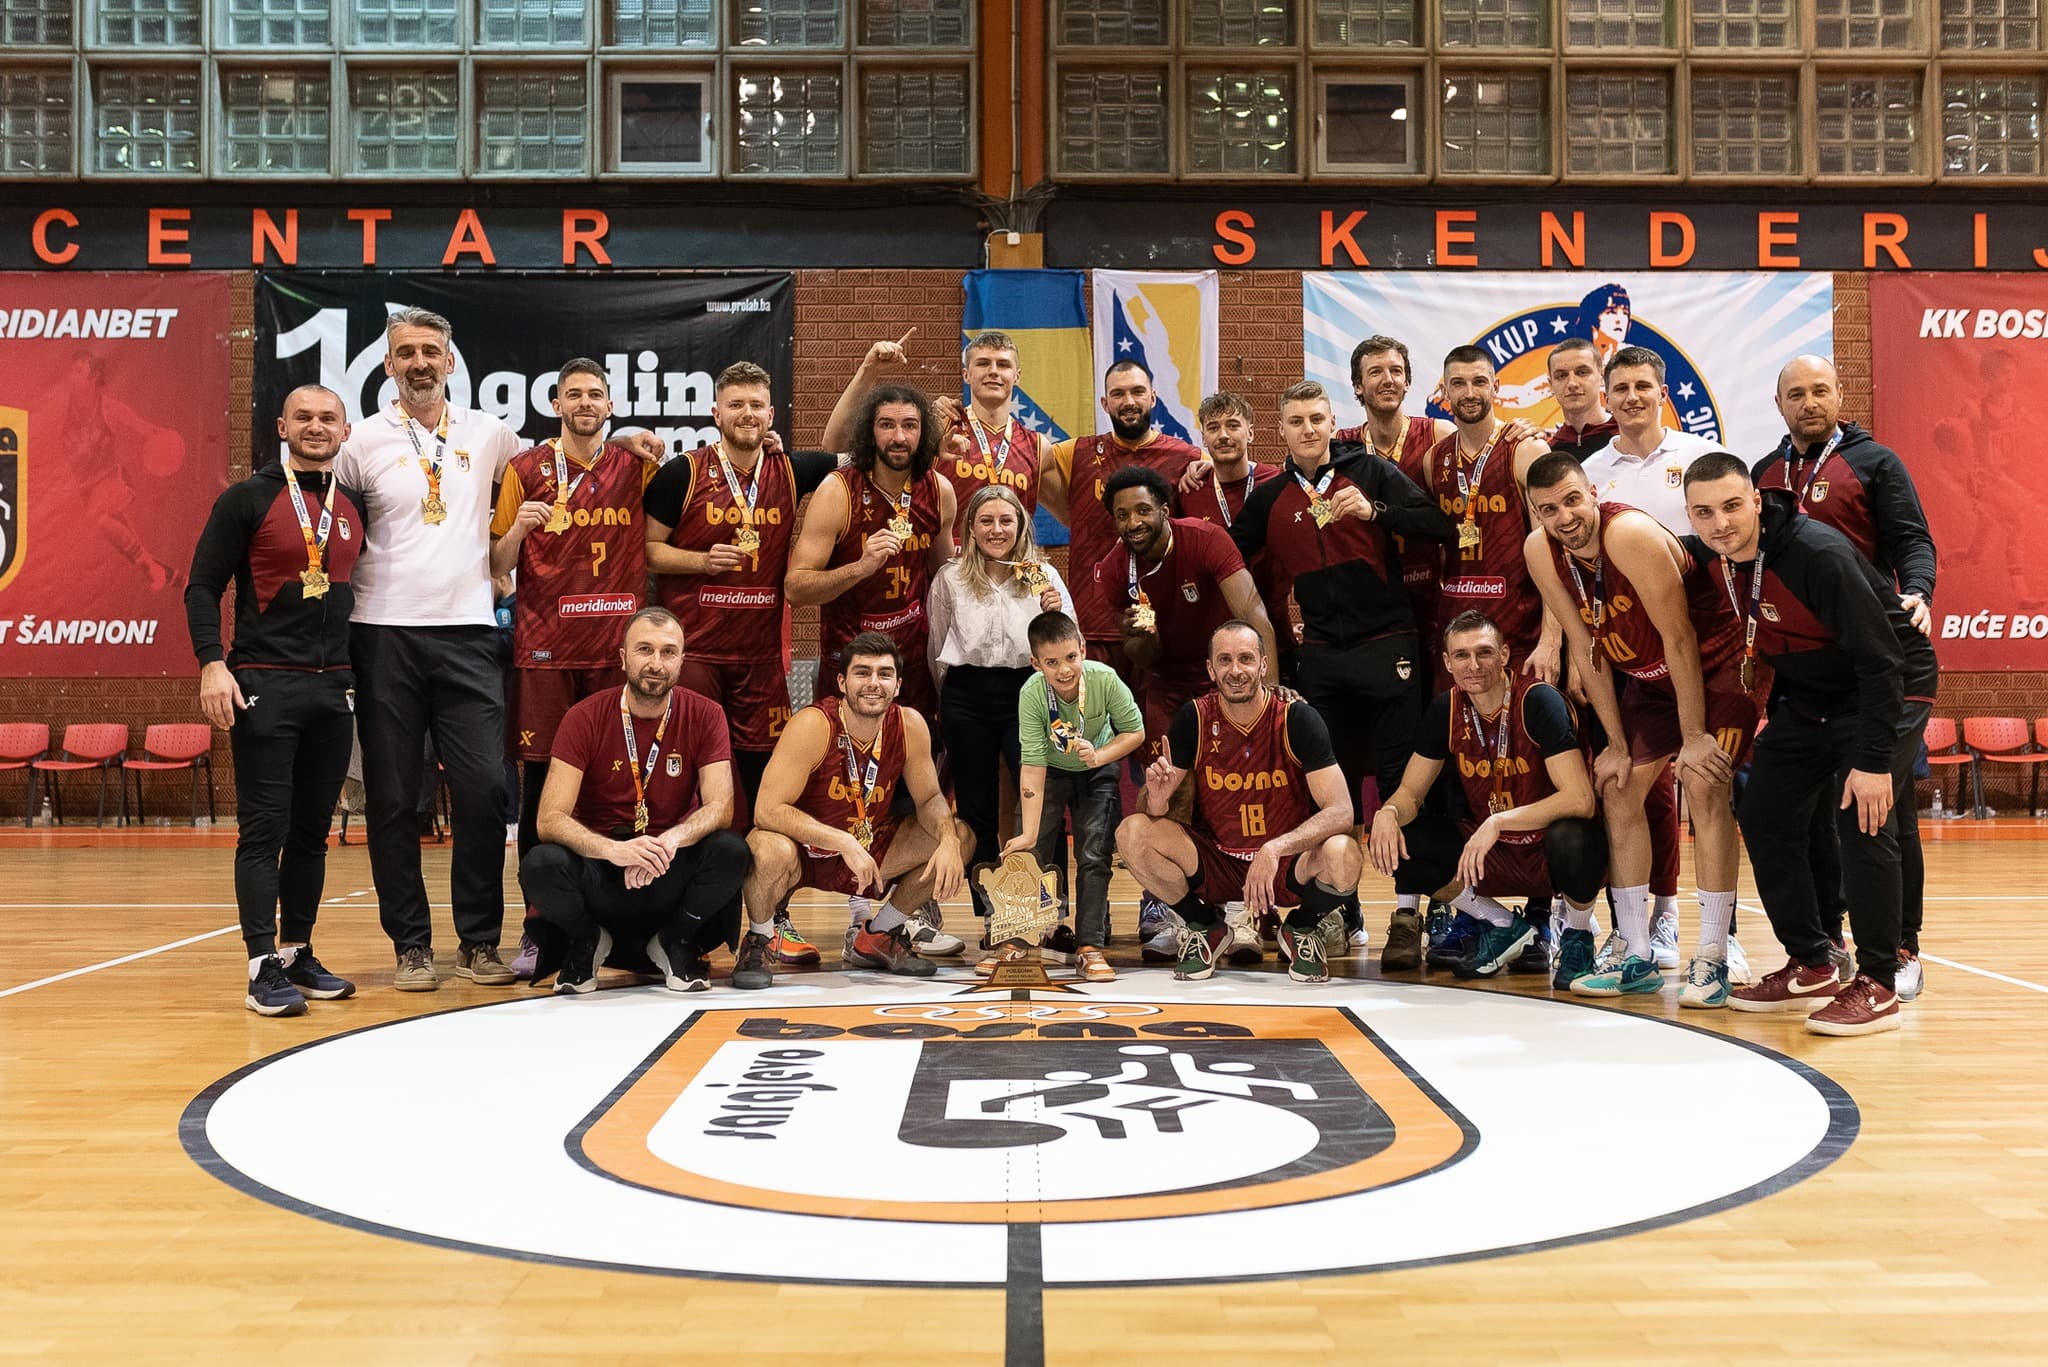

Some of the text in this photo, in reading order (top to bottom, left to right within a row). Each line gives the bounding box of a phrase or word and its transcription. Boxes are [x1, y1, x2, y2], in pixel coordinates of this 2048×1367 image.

[32, 208, 611, 265] CENTAR
[706, 298, 771, 314] www.prolab.ba
[1919, 309, 2048, 339] KK BOS
[1487, 319, 1539, 364] KUP
[955, 459, 1028, 491] bona
[706, 501, 782, 526] bona
[1439, 493, 1507, 516] bona
[591, 542, 606, 577] 7
[702, 590, 776, 605] meridianbet
[885, 566, 911, 600] 34
[561, 599, 634, 614] meridianbet
[16, 614, 158, 645] ŠAMPION!
[1941, 609, 2007, 639] BIĆE
[1601, 632, 1637, 662] 10
[1205, 765, 1289, 791] bosna
[1458, 752, 1531, 778] bona
[1239, 803, 1267, 837] 18
[736, 1017, 1255, 1041] bosna
[703, 1048, 839, 1140] sarajevo
